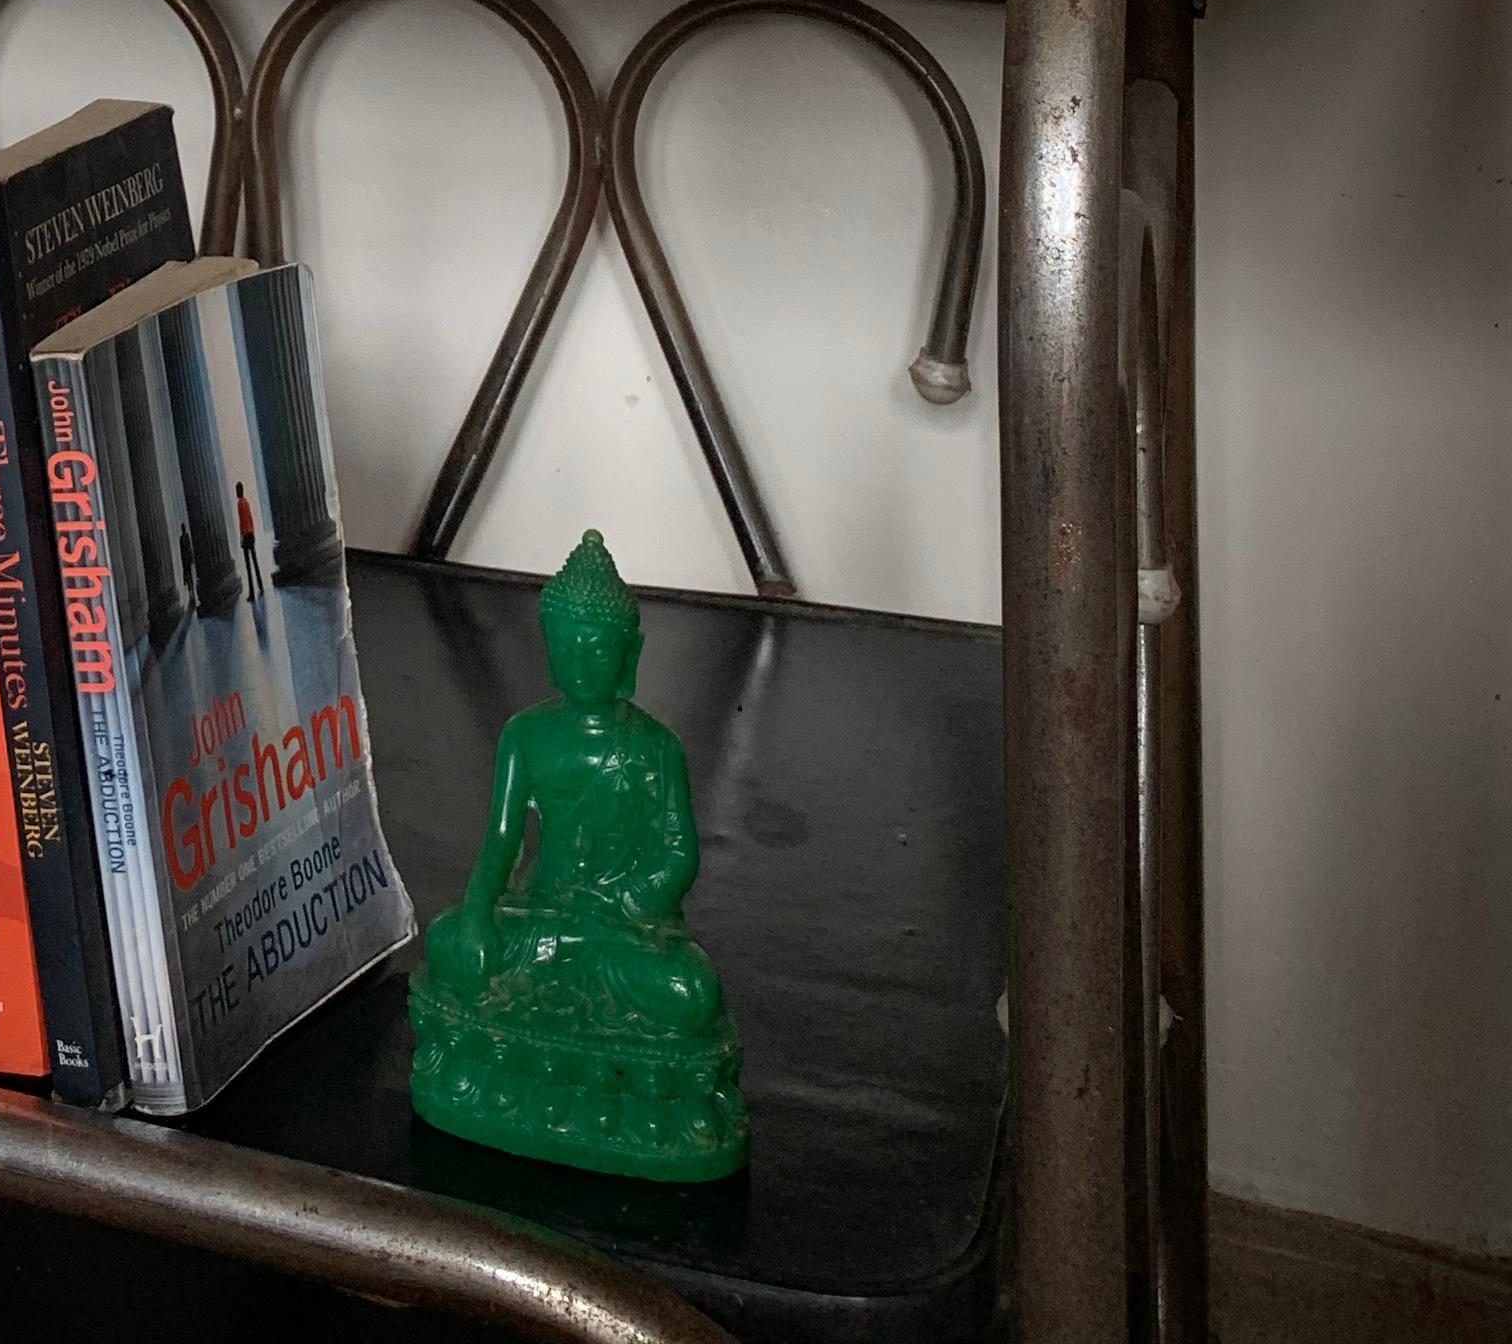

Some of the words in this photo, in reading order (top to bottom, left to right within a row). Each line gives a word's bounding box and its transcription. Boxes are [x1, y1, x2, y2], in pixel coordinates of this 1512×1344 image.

[24, 203, 84, 264] STEVEN
[85, 163, 164, 226] WEINBERG
[48, 380, 74, 442] John
[48, 450, 115, 693] Grisham
[93, 711, 109, 746] THE
[189, 690, 247, 768] John
[12, 721, 43, 859] WEINBERG
[33, 741, 61, 843] STEVEN
[98, 754, 126, 874] ABDUCTION
[113, 734, 130, 798] Theodore
[122, 803, 137, 847] Boone
[163, 693, 362, 891] Grisham
[181, 904, 199, 931] THE
[200, 872, 237, 913] NUMBER
[322, 779, 361, 815] AUTHOR
[214, 875, 288, 954] Theodore
[290, 833, 341, 894] Boone
[192, 965, 241, 1039] THE
[247, 849, 388, 994] ABDUCTION
[57, 1039, 83, 1056] Basic
[59, 1053, 89, 1069] Books
